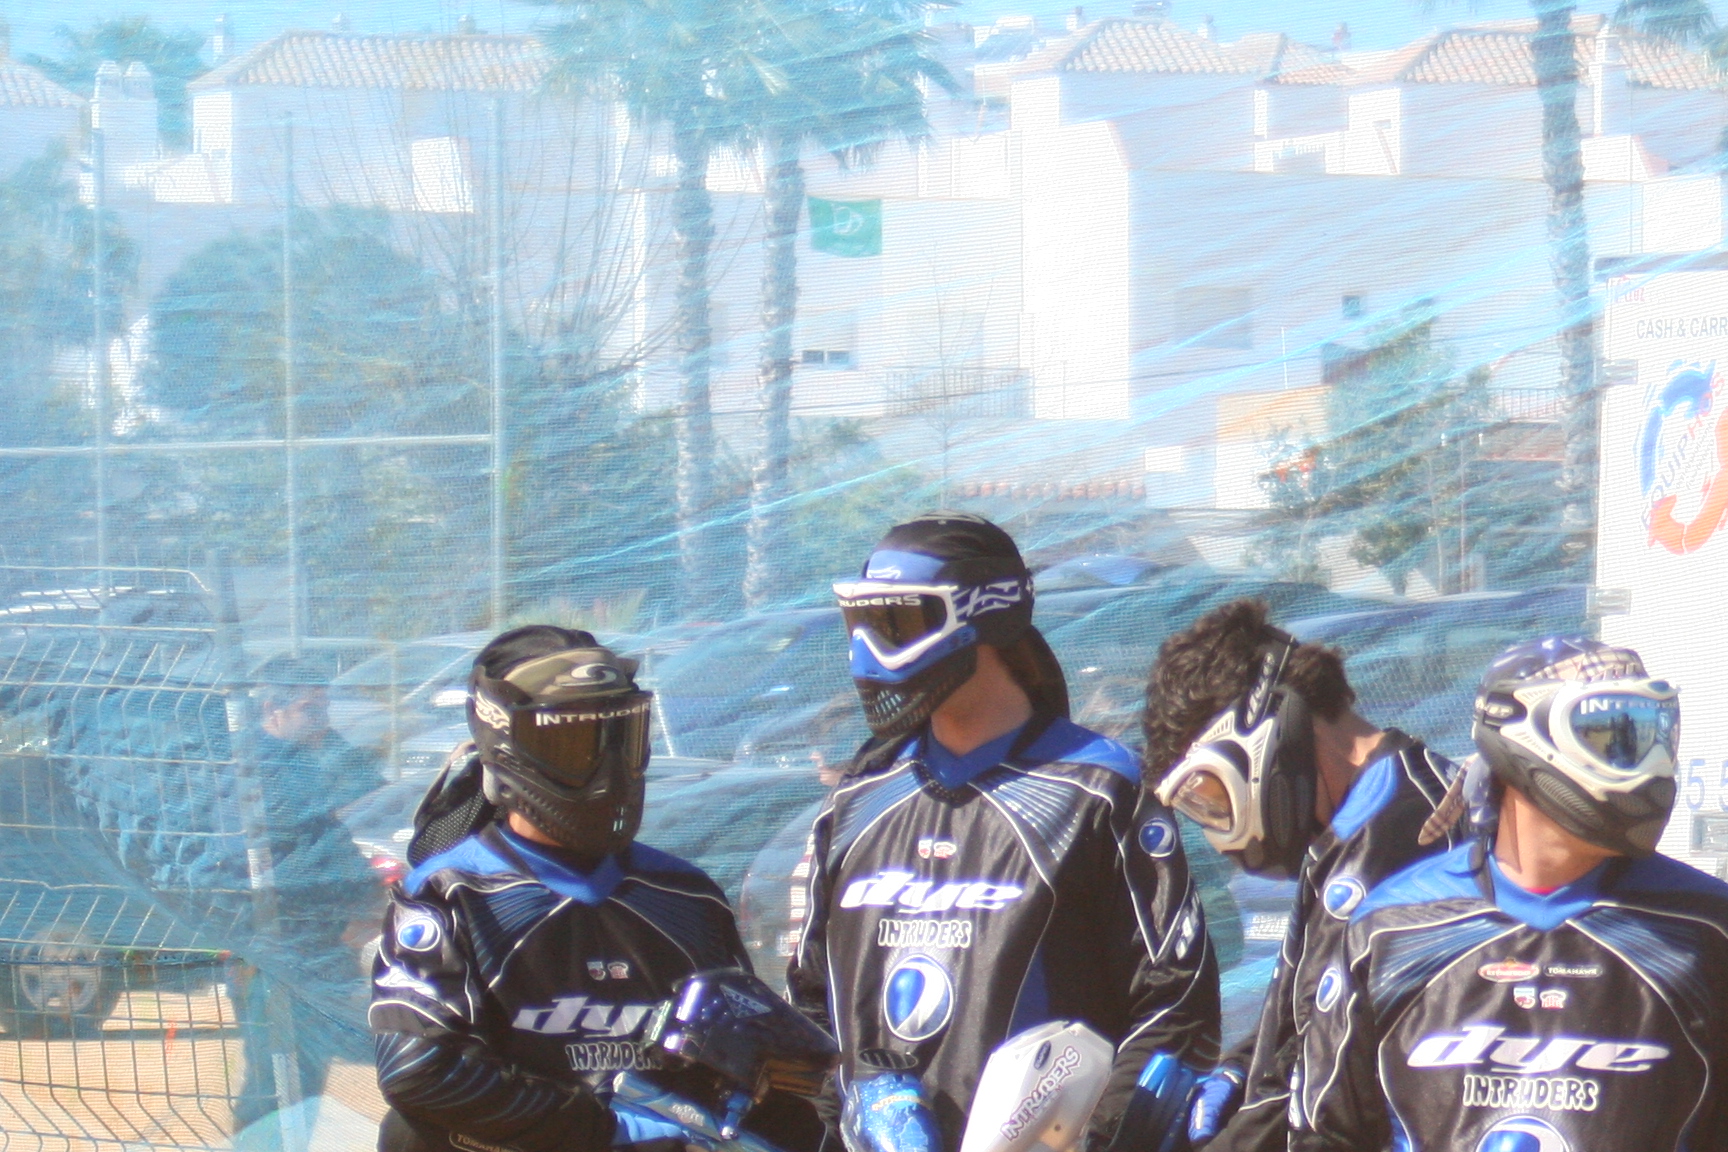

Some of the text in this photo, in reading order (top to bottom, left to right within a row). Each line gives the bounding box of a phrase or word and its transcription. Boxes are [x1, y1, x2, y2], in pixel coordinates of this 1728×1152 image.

[1636, 318, 1673, 340] CASH
[1676, 317, 1687, 338] &
[839, 871, 1023, 915] dye
[877, 918, 973, 949] INTRUDERS
[1406, 1026, 1670, 1074] dye
[1000, 1045, 1081, 1142] INTRUDERS
[1462, 1074, 1599, 1112] INTRUDERS
